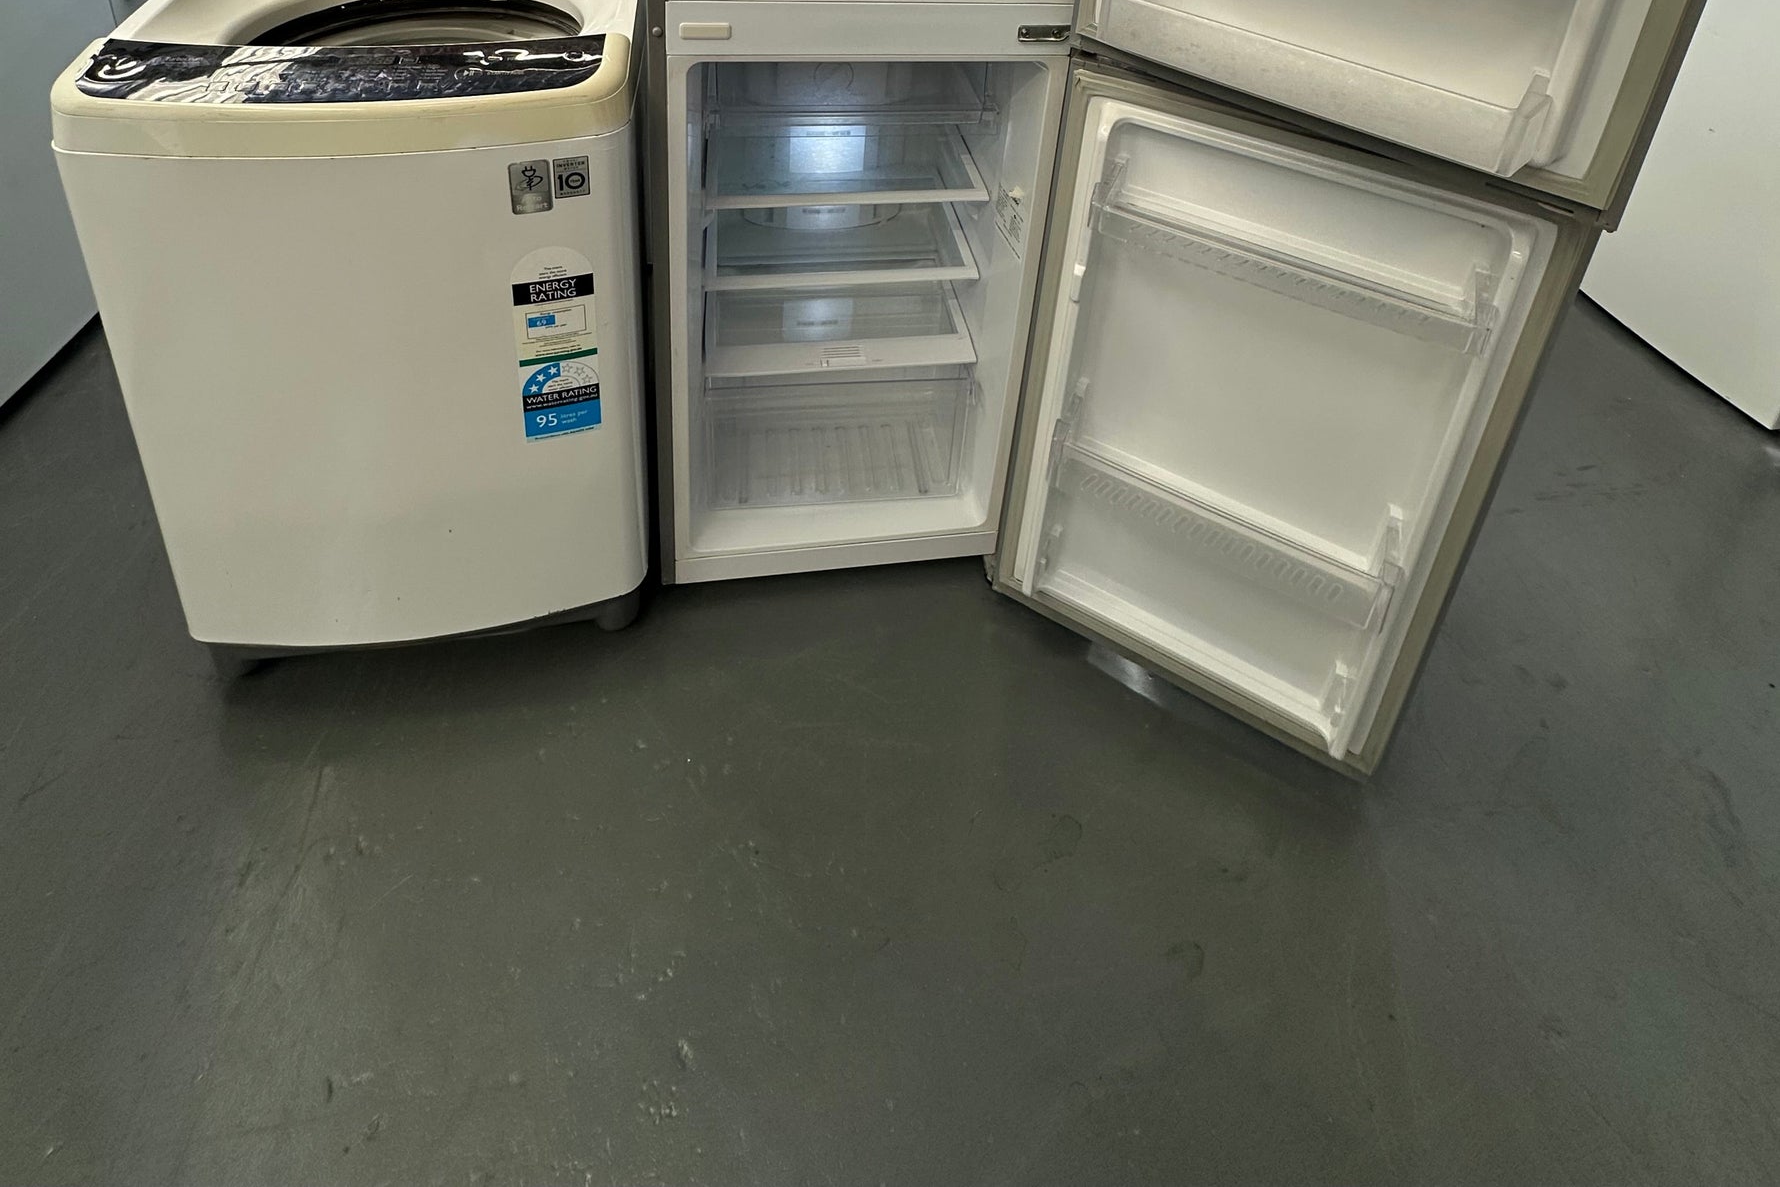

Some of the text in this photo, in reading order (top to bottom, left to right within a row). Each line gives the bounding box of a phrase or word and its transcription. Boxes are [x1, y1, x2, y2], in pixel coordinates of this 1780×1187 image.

[558, 171, 586, 192] 10
[529, 278, 577, 294] ENERGY
[530, 287, 577, 302] RATING
[526, 385, 597, 404] WATER RATING
[536, 413, 558, 428] 95
